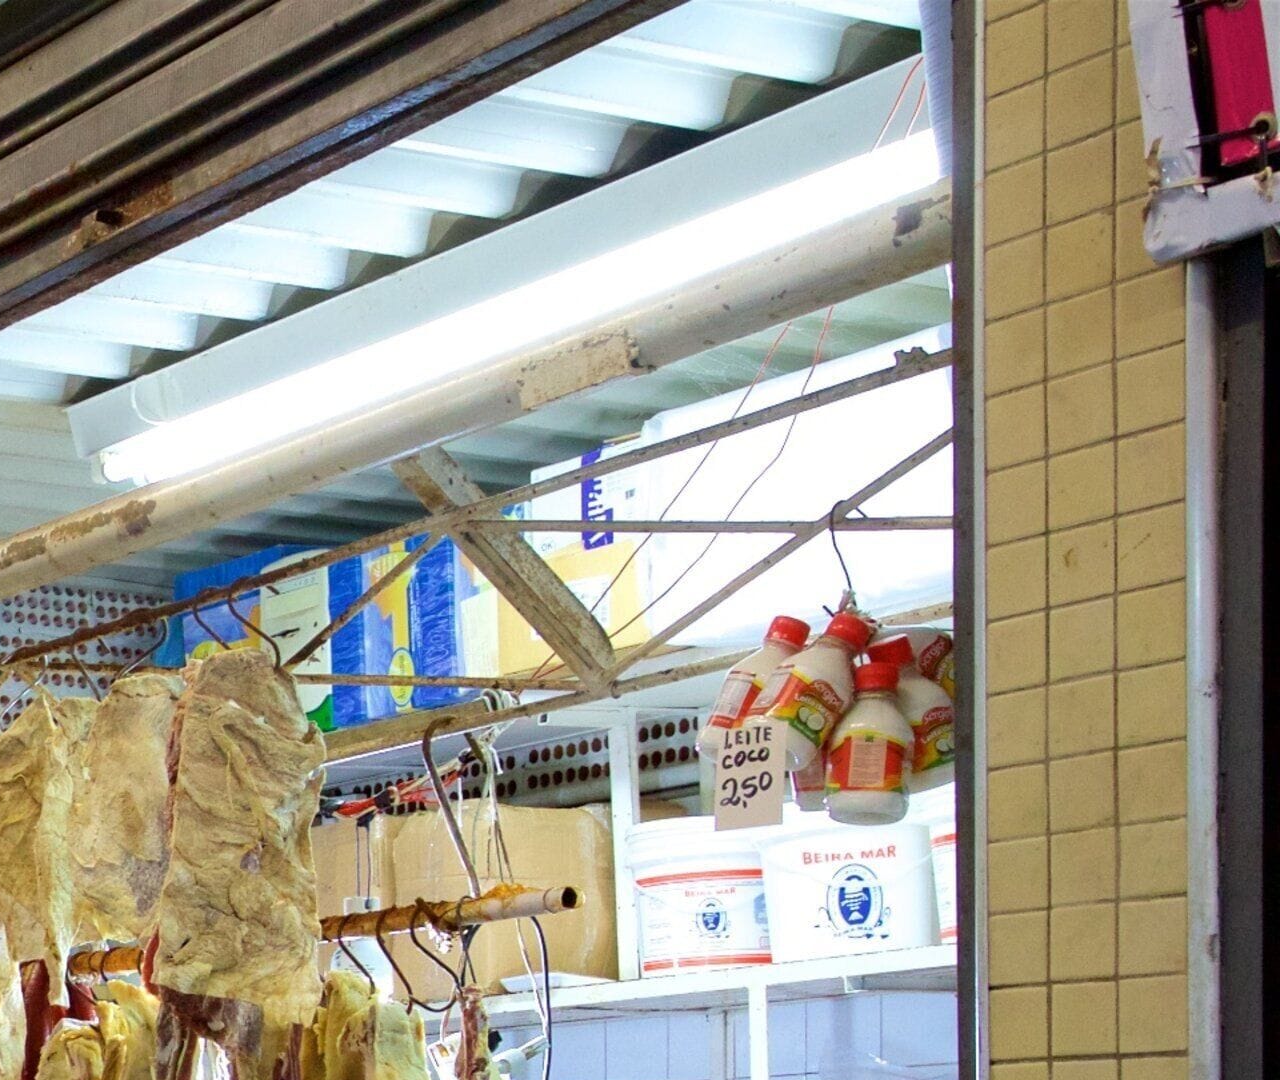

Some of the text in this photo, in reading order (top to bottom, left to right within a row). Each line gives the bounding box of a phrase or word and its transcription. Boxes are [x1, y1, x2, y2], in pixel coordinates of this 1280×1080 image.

[724, 727, 773, 750] LEITE
[721, 746, 771, 770] COCO
[802, 845, 897, 865] BEIRA MAR
